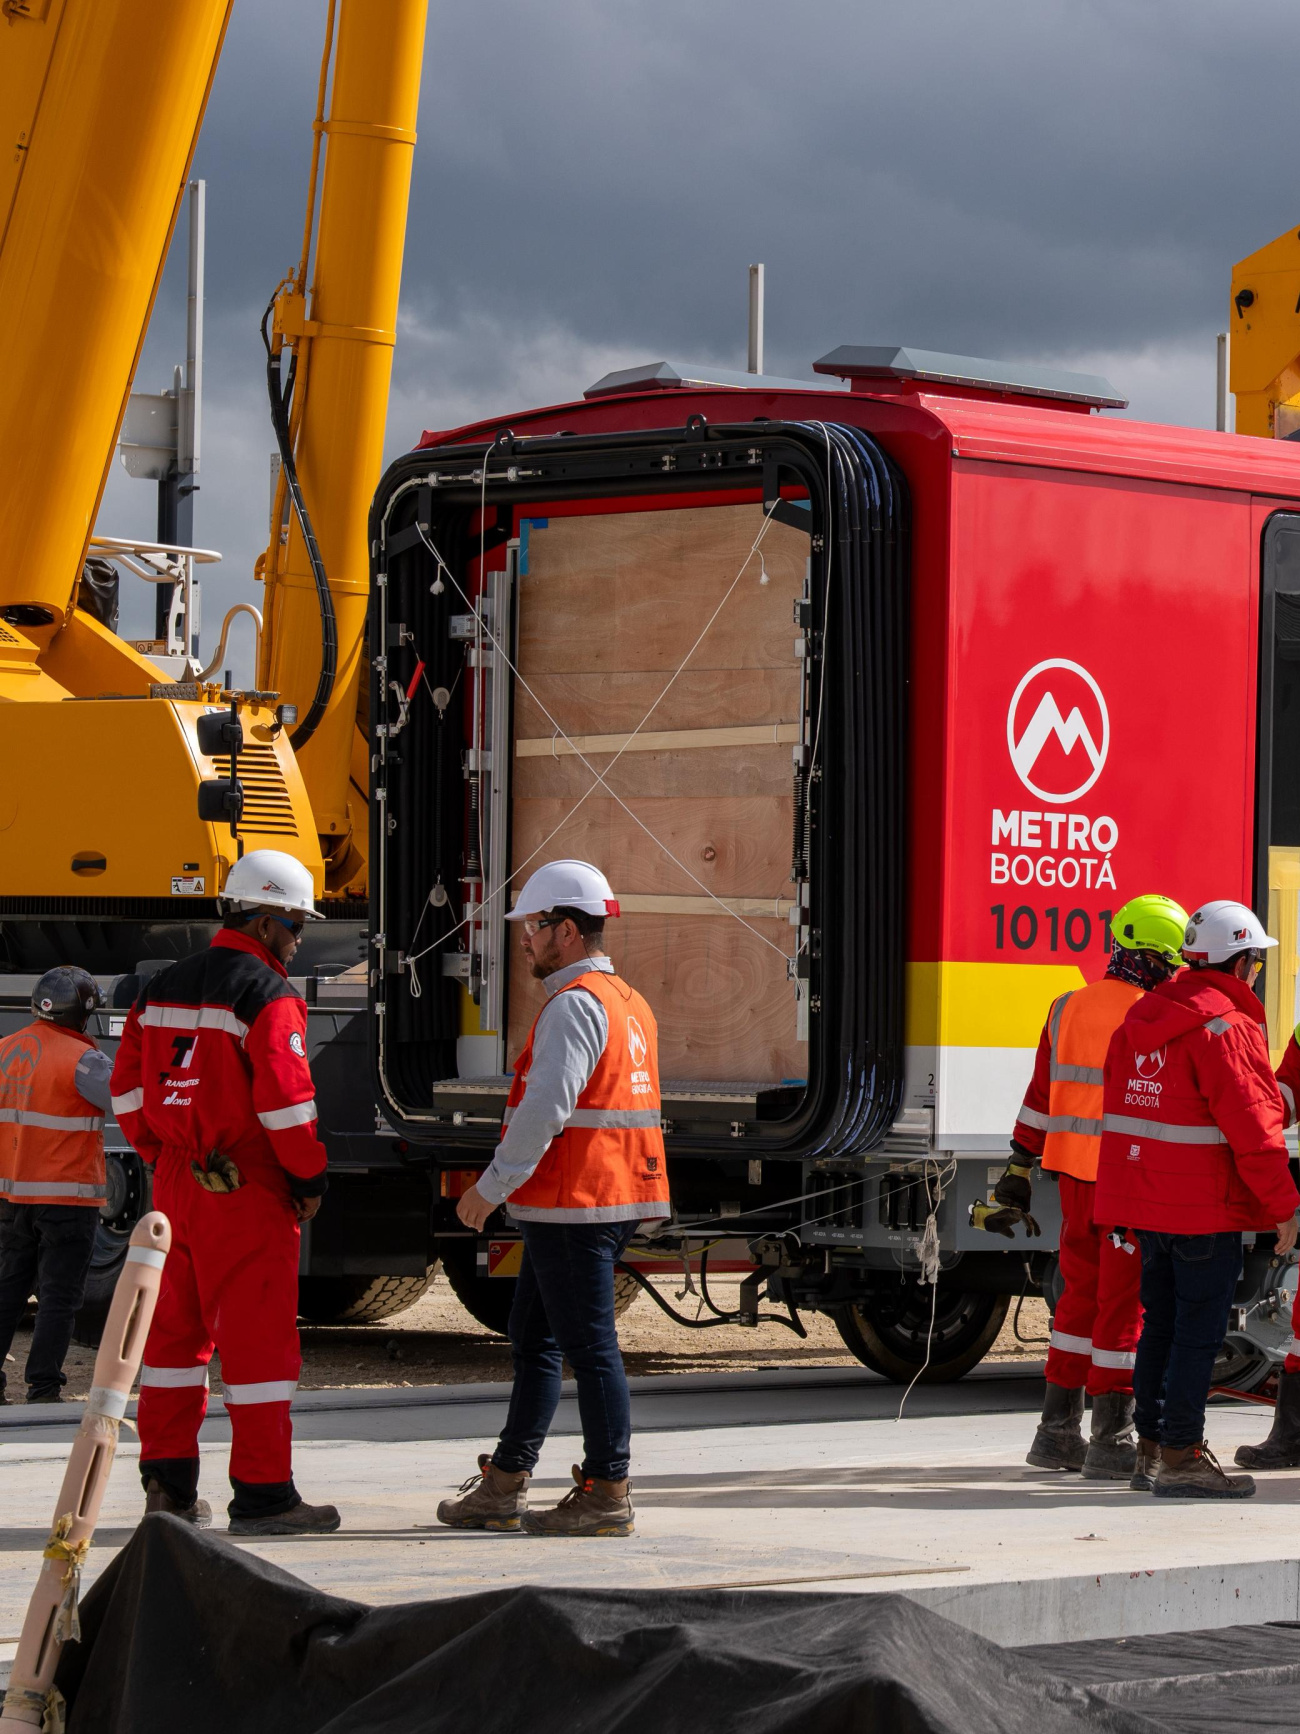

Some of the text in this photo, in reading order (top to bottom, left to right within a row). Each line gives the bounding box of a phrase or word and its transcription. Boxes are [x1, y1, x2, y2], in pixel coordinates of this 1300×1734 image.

[991, 808, 1119, 852] METRO
[990, 852, 1117, 890] BOGOTÁ
[928, 1073, 935, 1086] 2
[1127, 1079, 1163, 1095] METRO
[1124, 1093, 1160, 1108] BOGOTÁ
